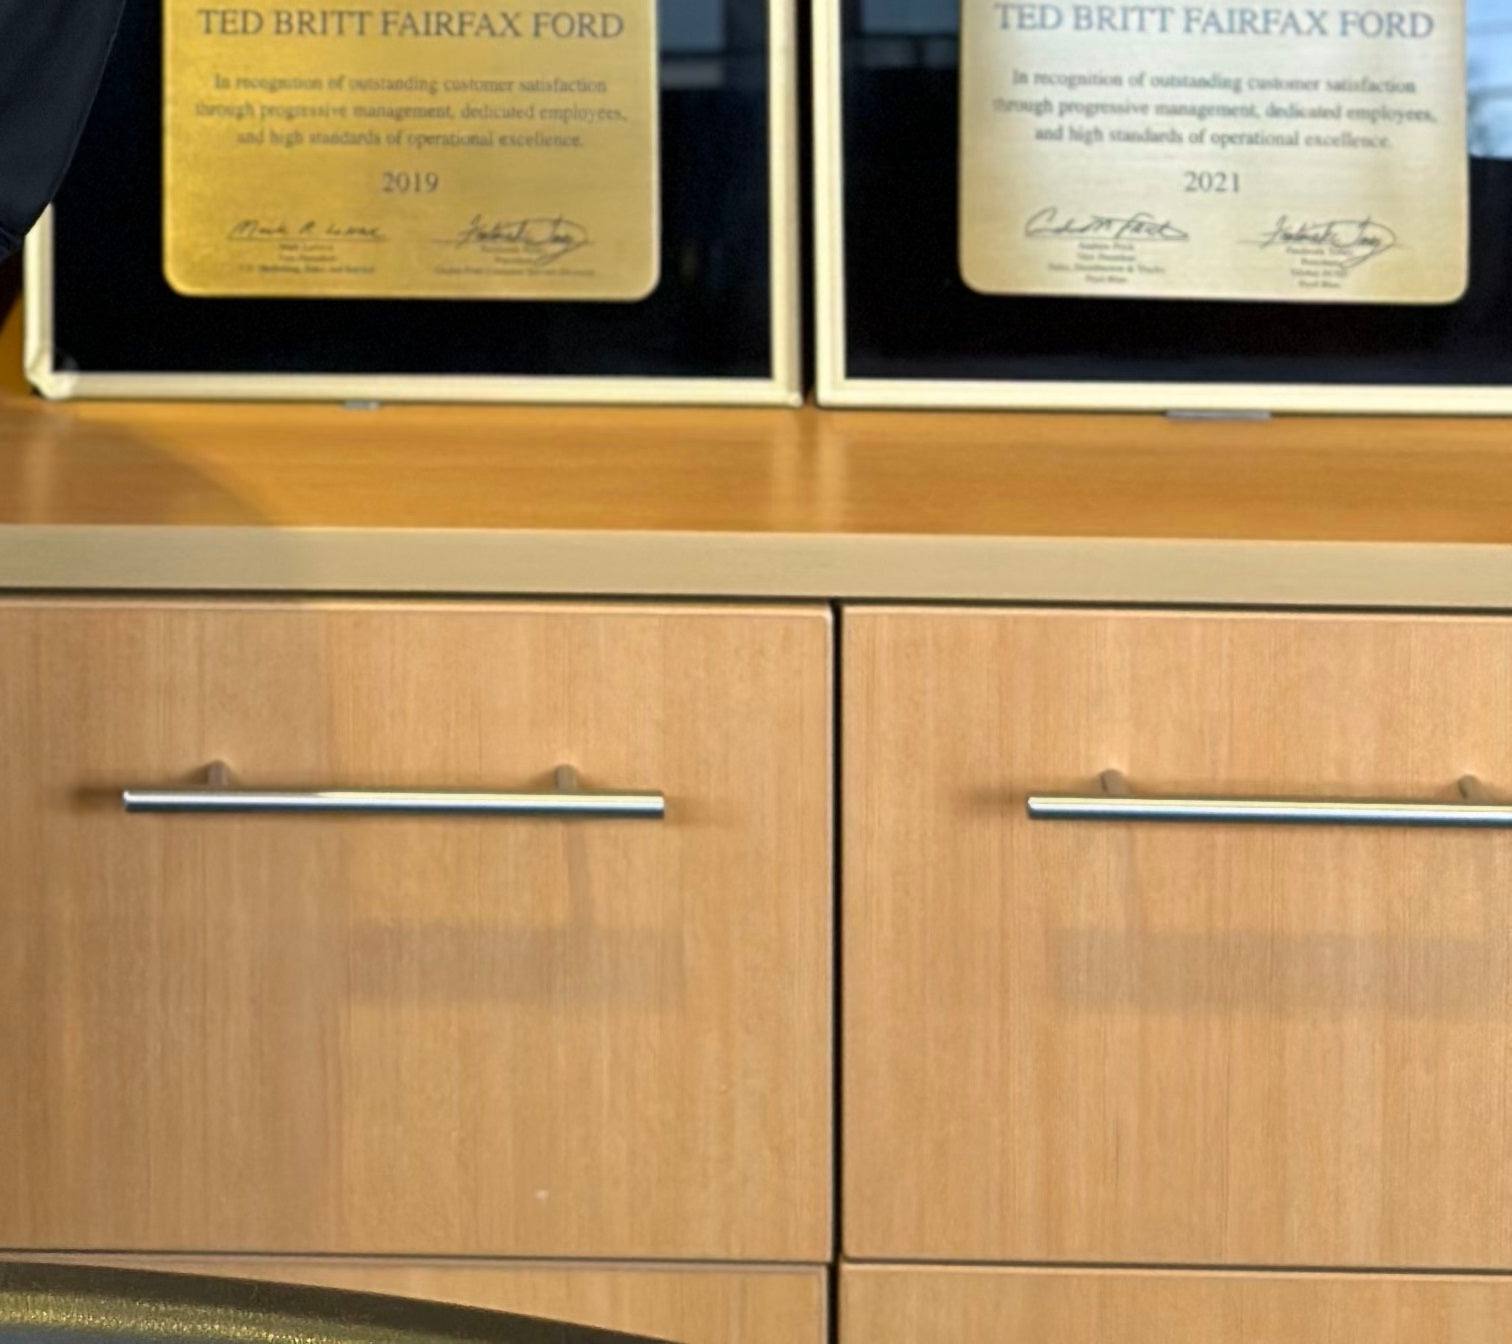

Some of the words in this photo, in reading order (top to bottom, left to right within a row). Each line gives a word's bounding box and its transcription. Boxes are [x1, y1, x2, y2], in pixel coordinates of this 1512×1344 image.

[197, 8, 264, 36] TED
[273, 9, 373, 37] BRITT
[380, 10, 522, 38] FAIRFAX
[532, 11, 625, 39] FORD
[993, 1, 1064, 31] TED
[1073, 3, 1175, 33] BRITT
[1183, 6, 1329, 36] FAIRFAX
[1339, 10, 1435, 39] FORD
[443, 76, 514, 92] customer
[1033, 70, 1123, 90] recognition
[1128, 71, 1147, 87] of
[1150, 72, 1243, 94] outstanding
[1246, 75, 1320, 92] customer
[1325, 76, 1417, 94] satisfaction
[1034, 126, 1064, 142] and
[1067, 126, 1103, 146] high
[1108, 127, 1184, 145] standards
[1188, 128, 1206, 145] of
[1209, 129, 1300, 149] operational
[382, 171, 439, 193] 2019
[1183, 170, 1240, 193] 2021
